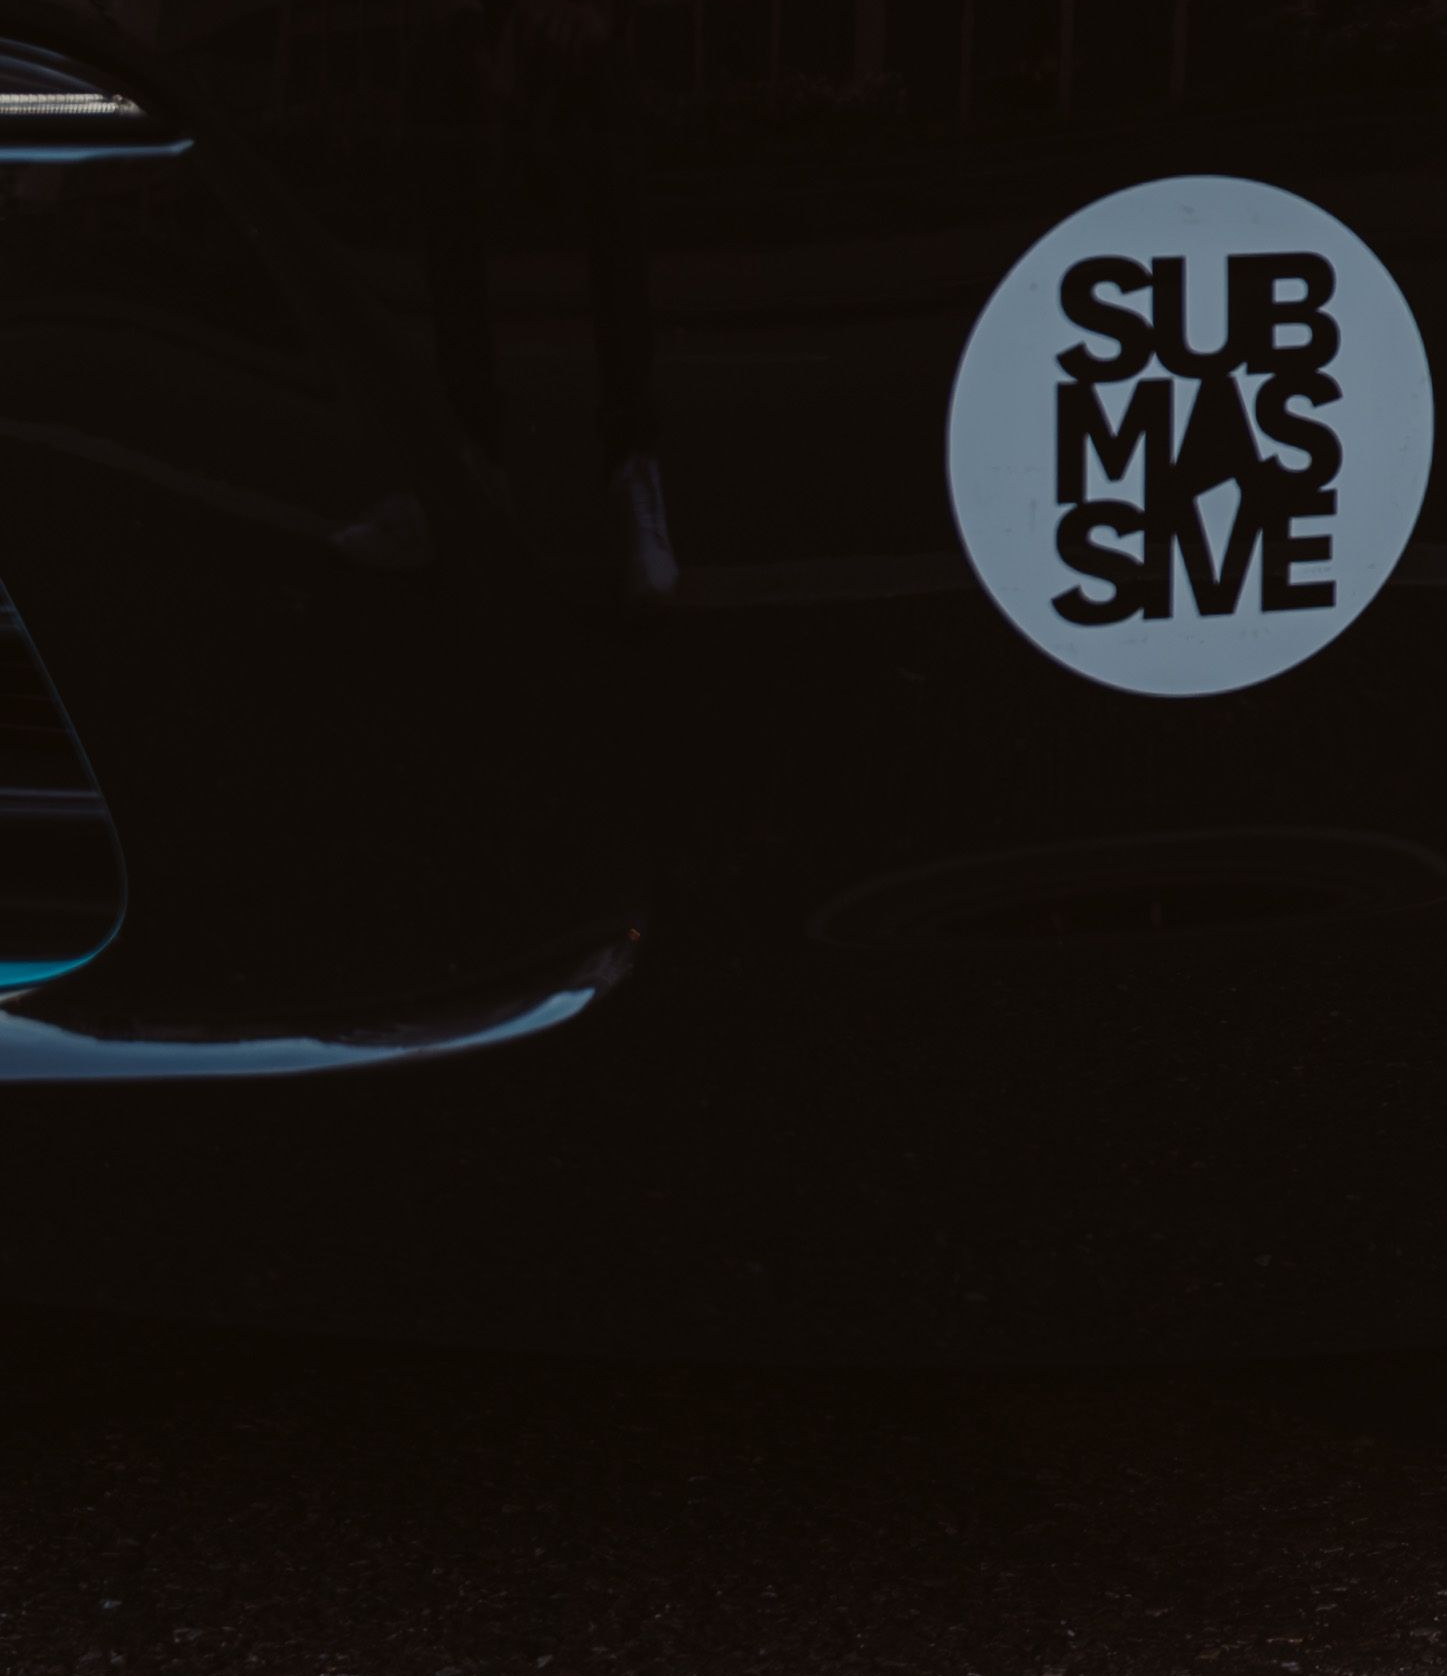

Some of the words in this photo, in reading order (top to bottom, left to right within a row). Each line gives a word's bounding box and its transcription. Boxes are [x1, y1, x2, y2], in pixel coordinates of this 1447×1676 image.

[1055, 251, 1341, 383] SUB
[1055, 370, 1344, 506] MAS
[1051, 489, 1337, 626] SIVE
